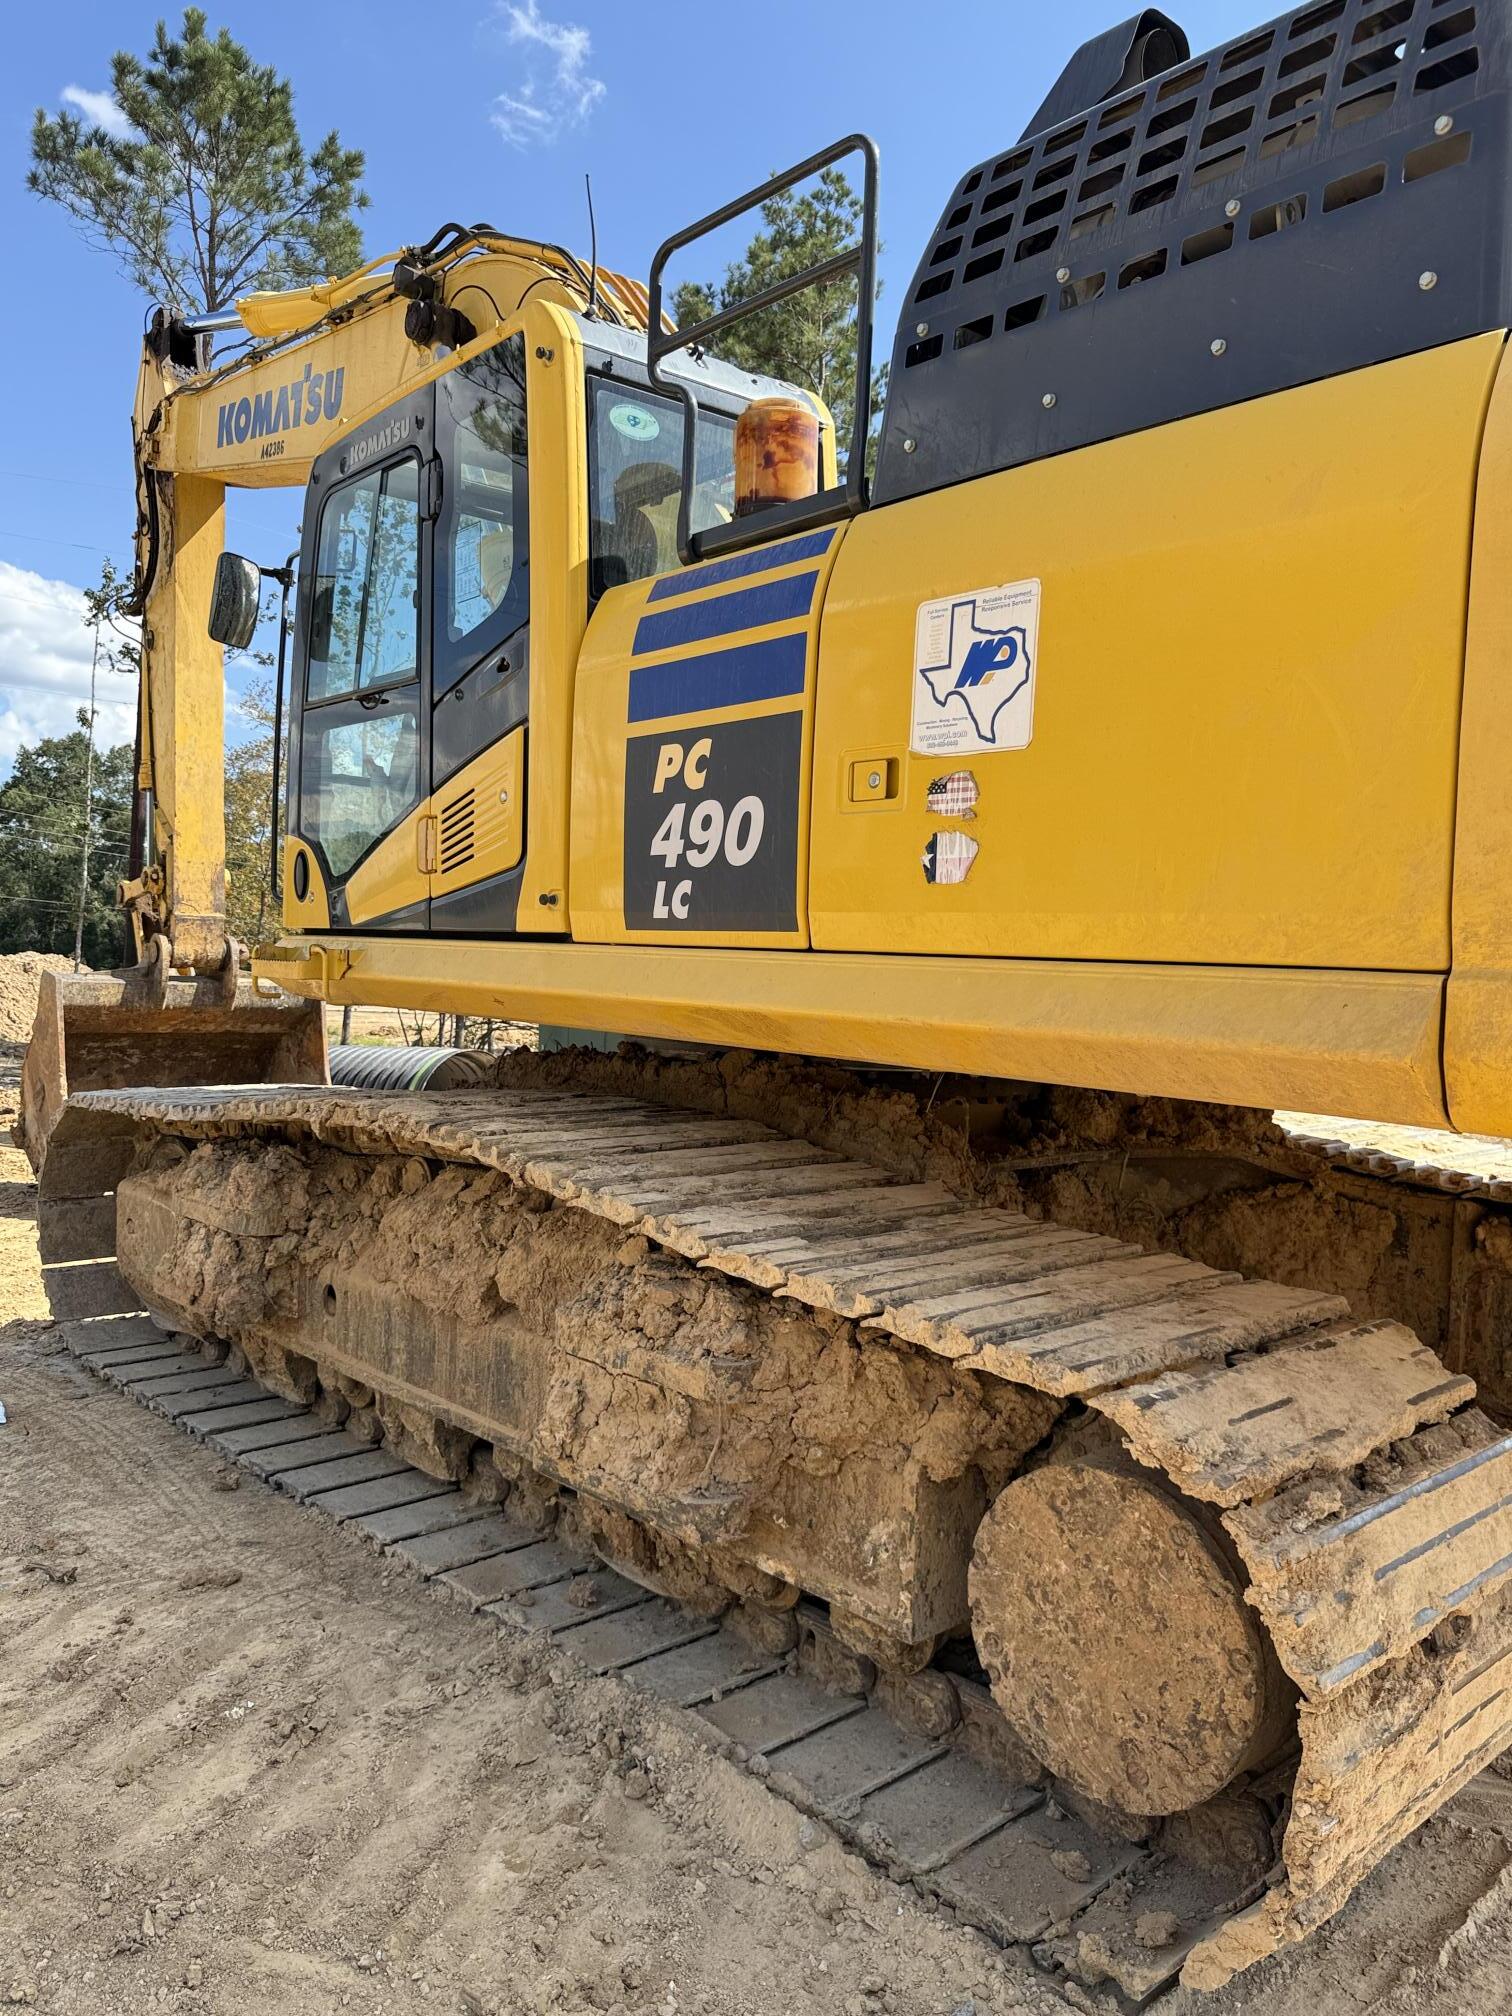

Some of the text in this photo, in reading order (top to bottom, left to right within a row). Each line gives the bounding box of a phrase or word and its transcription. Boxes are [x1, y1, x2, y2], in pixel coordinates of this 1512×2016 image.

[217, 362, 345, 449] KOMATSU
[260, 439, 285, 460] A42386
[350, 416, 410, 466] KOMATSU
[652, 738, 713, 793] PC
[650, 795, 765, 868] 490
[652, 879, 693, 919] LC
